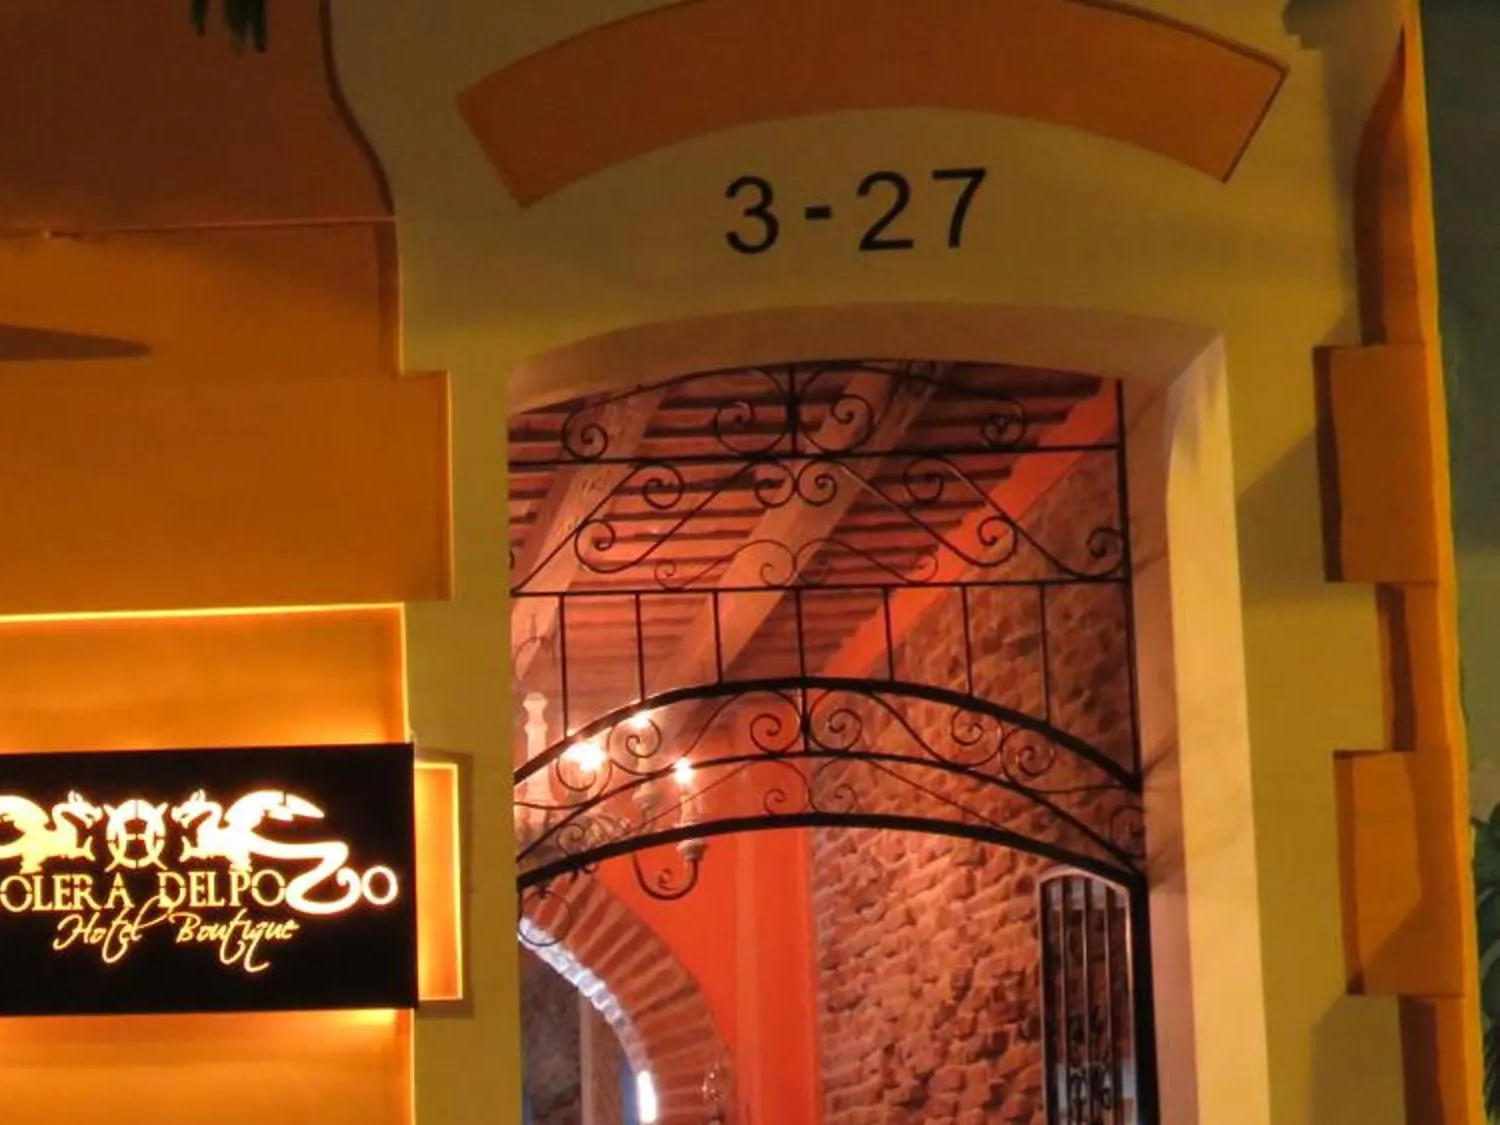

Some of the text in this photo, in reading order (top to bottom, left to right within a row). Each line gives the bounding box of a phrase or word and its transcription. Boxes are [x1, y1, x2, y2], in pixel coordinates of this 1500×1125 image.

[725, 168, 987, 254] 3-27
[53, 895, 300, 973] Hotel Boutique
